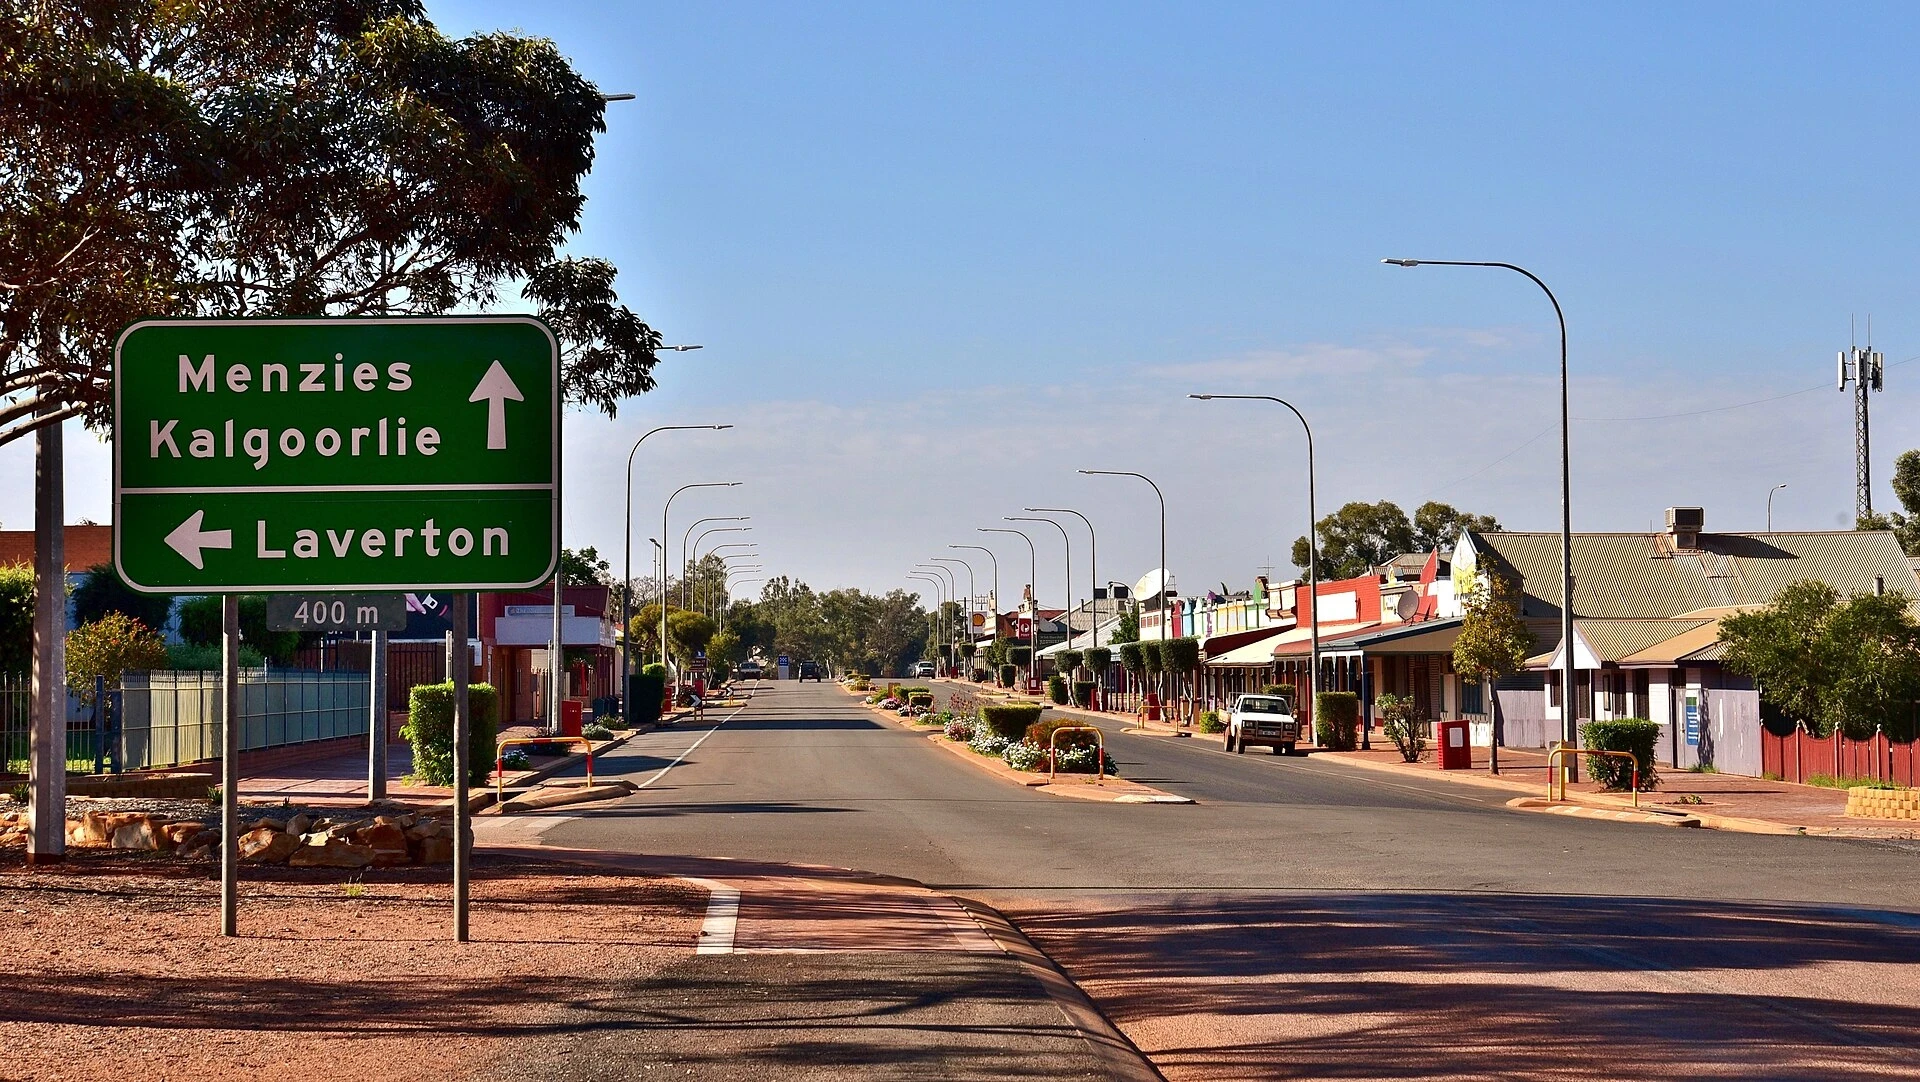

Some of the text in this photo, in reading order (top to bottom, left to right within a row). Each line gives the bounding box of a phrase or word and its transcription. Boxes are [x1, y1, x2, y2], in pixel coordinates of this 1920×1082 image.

[178, 352, 413, 393] Menzies
[150, 416, 441, 471] Kalgoorlie
[257, 518, 509, 559] Laverton
[294, 601, 378, 625] 400 m
